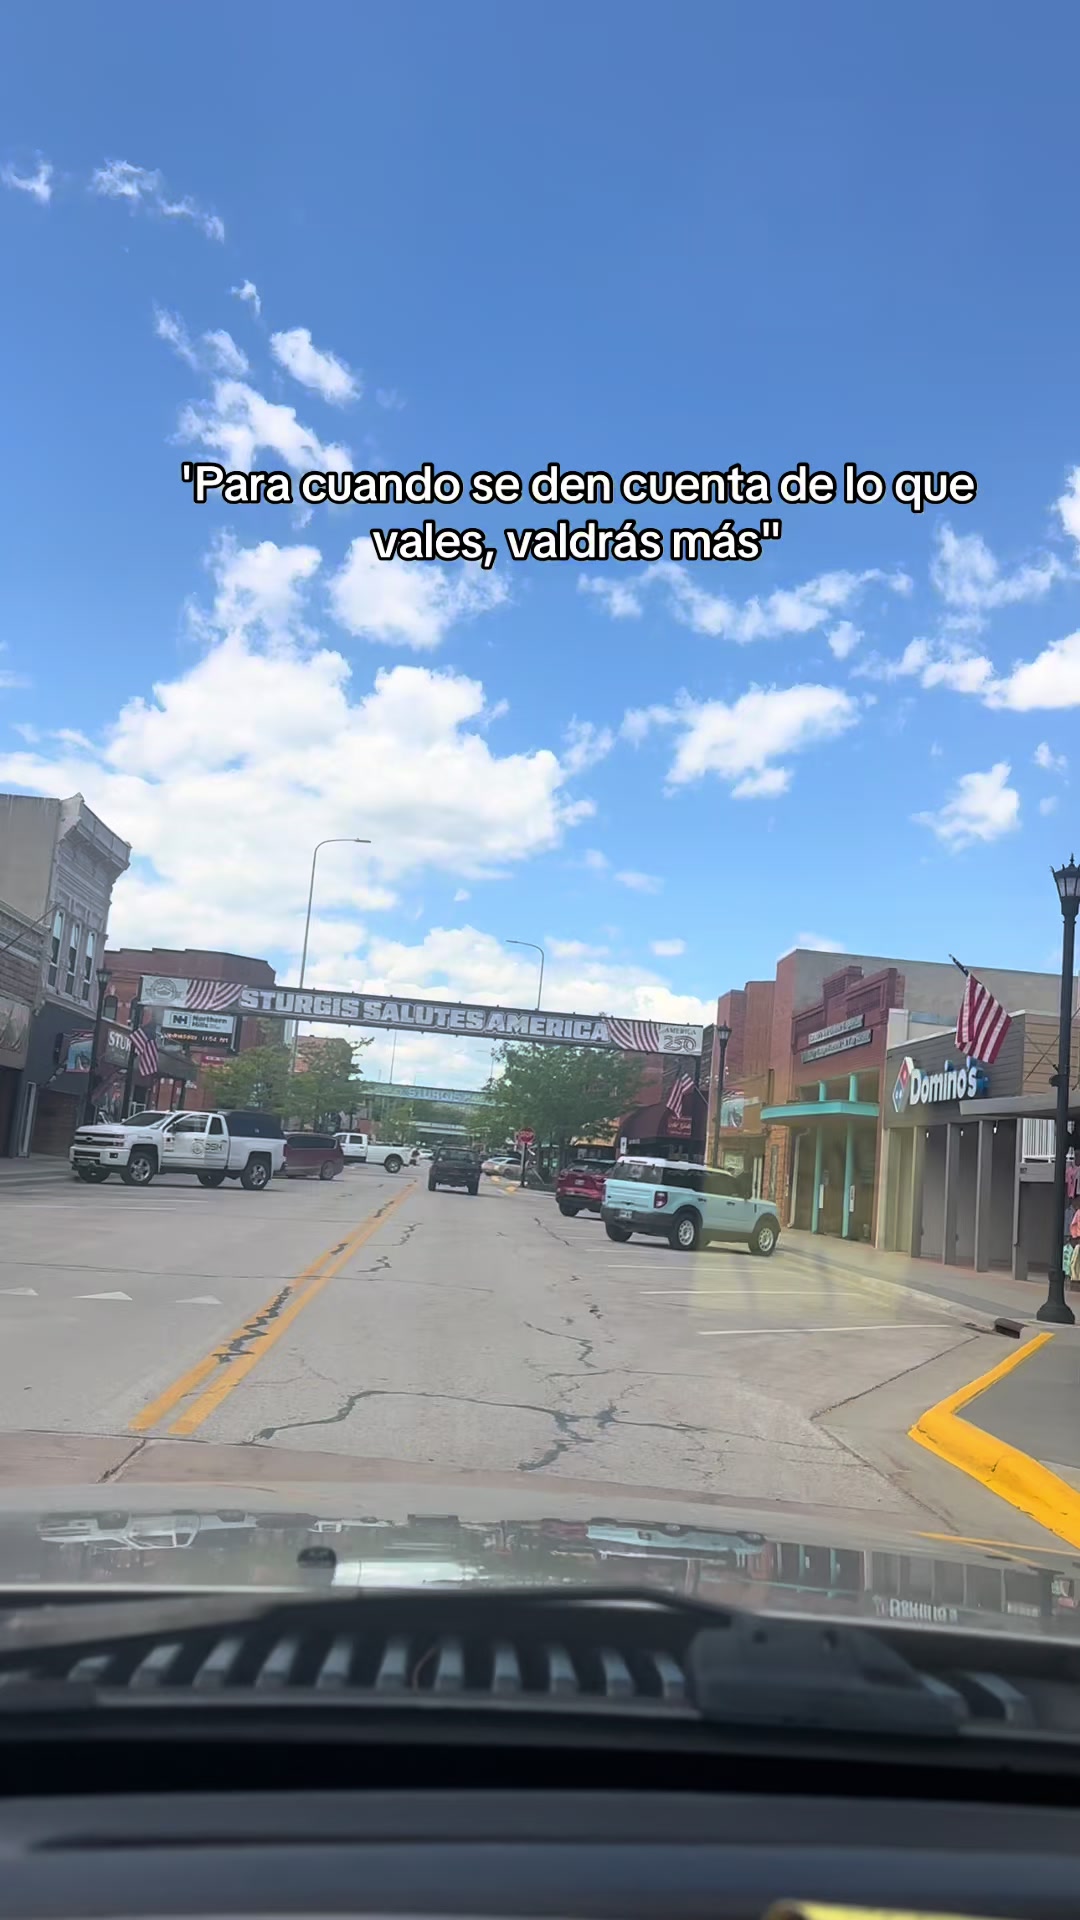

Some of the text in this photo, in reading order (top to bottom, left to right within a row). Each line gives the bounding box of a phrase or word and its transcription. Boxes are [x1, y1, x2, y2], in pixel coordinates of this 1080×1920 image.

[192, 1014, 228, 1024] Northern
[240, 989, 610, 1042] STURGIS SALUTES AMERICA
[664, 1027, 697, 1036] AMERICA
[663, 1035, 697, 1052] 250
[909, 1055, 978, 1106] Domino's
[408, 1088, 461, 1101] STURGIS
